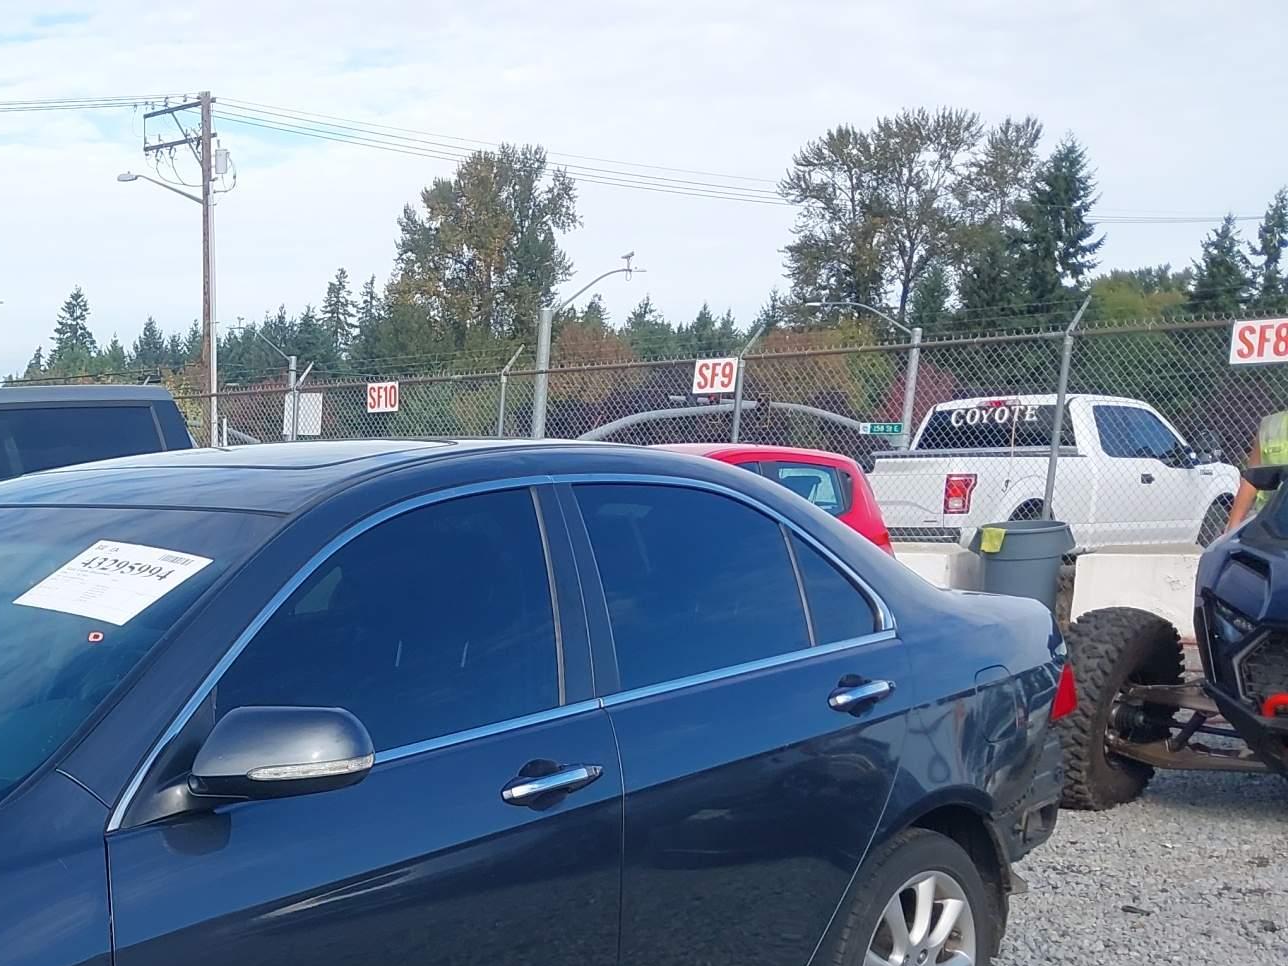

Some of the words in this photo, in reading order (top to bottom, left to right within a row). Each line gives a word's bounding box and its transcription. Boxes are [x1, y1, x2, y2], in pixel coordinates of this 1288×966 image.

[1237, 323, 1288, 359] SF8
[696, 361, 734, 389] SF9
[368, 384, 397, 409] SF10
[951, 405, 1040, 427] COYOTE
[81, 555, 175, 581] 43295994
